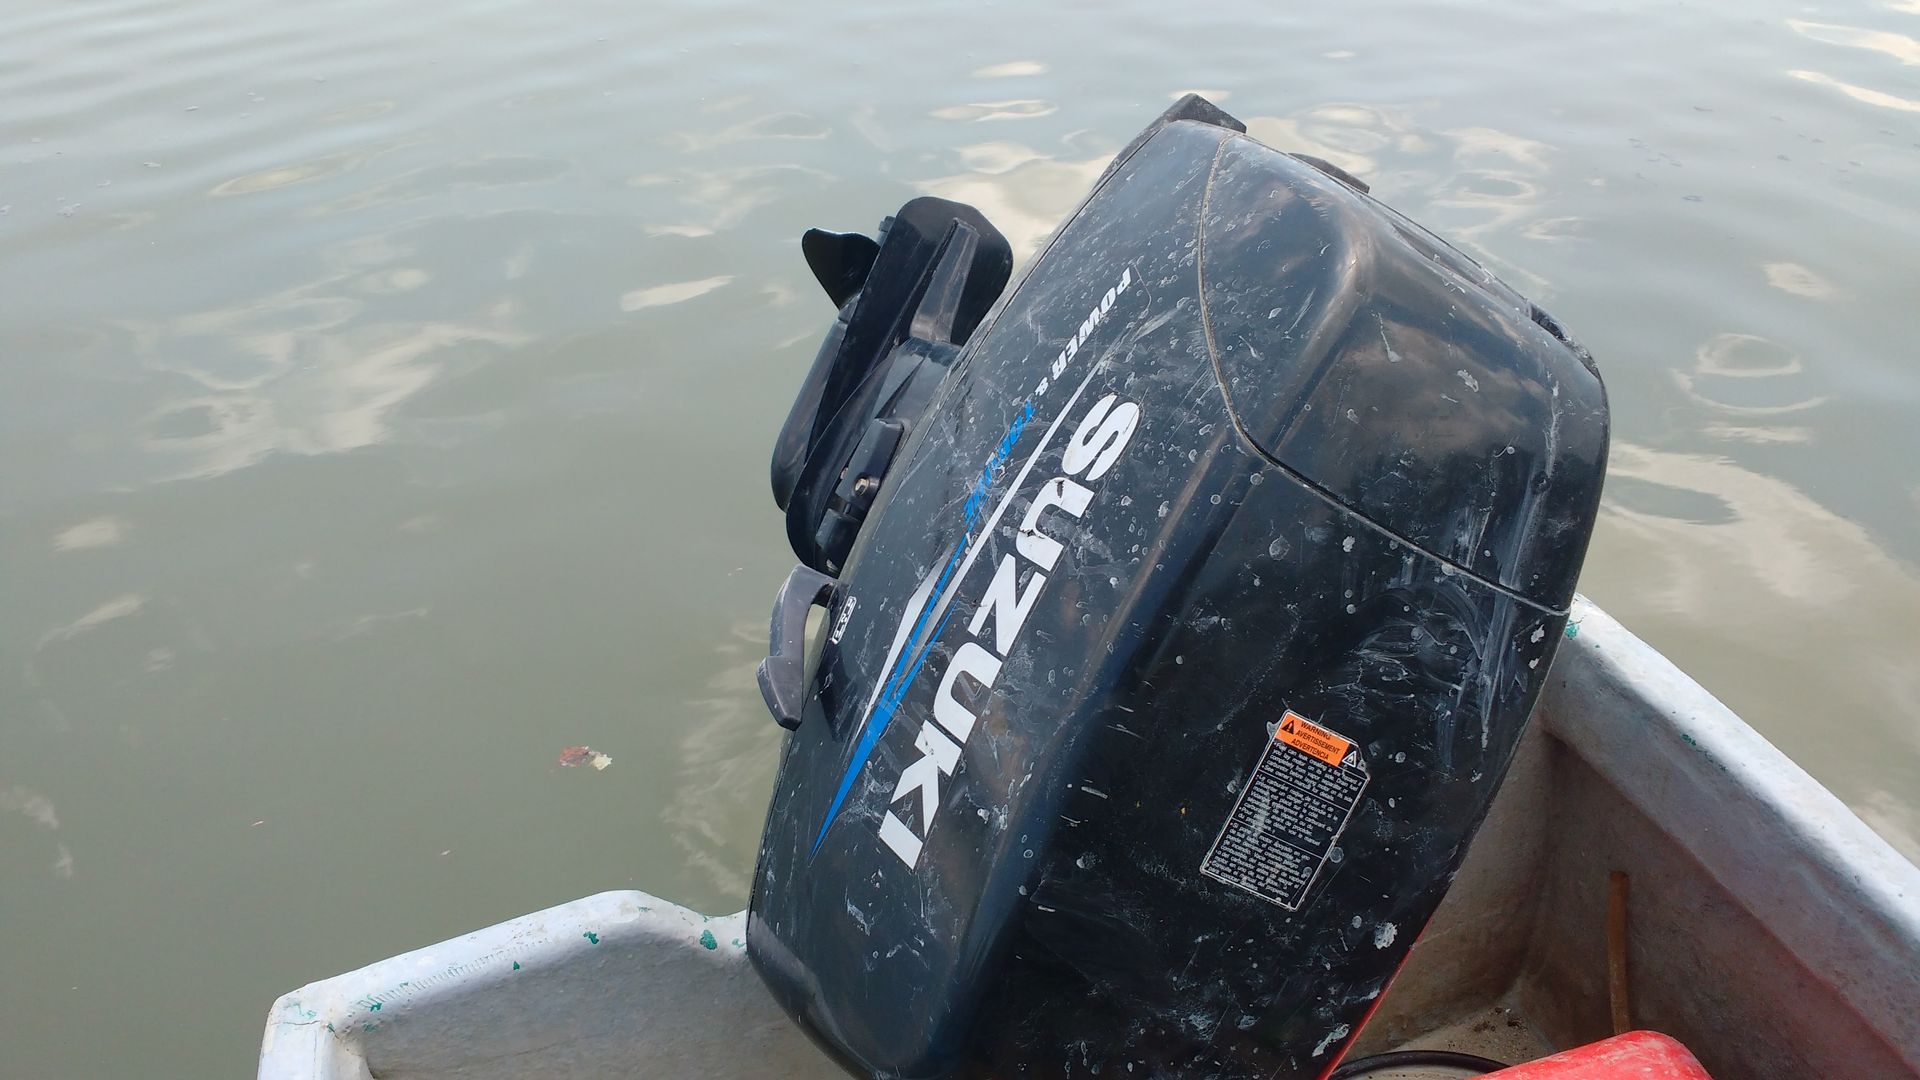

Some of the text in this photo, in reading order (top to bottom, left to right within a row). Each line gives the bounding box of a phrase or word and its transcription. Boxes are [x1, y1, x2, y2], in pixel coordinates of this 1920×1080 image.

[1052, 267, 1131, 380] POWER
[879, 393, 1139, 870] SUZUKI
[1294, 729, 1340, 755] AVERTISSEMENT
[1299, 720, 1332, 740] WARNING
[1290, 737, 1329, 760] ADVERTENCIA
